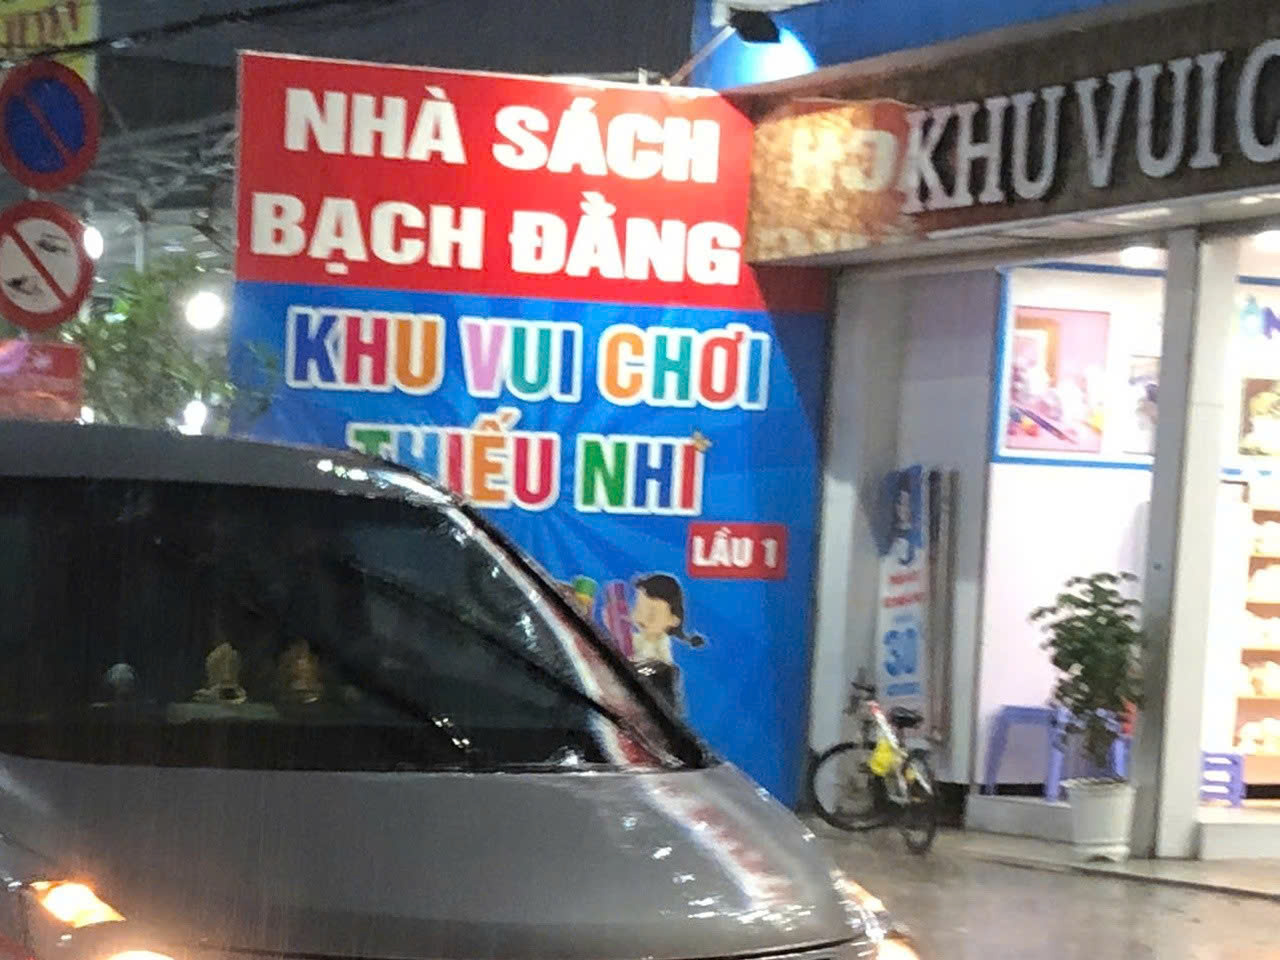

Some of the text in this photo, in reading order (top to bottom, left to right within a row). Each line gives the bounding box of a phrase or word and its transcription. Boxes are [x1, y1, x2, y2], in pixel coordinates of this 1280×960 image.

[284, 86, 466, 164] NHÀ
[492, 98, 718, 183] SÁCH
[898, 85, 1066, 214] KHU
[1074, 50, 1226, 188] VUI
[251, 191, 742, 285] BẠCH ĐẰNG
[286, 306, 770, 410] KHU VUI CHƠI
[575, 433, 704, 515] NHI
[692, 526, 778, 568] LẦU 1
